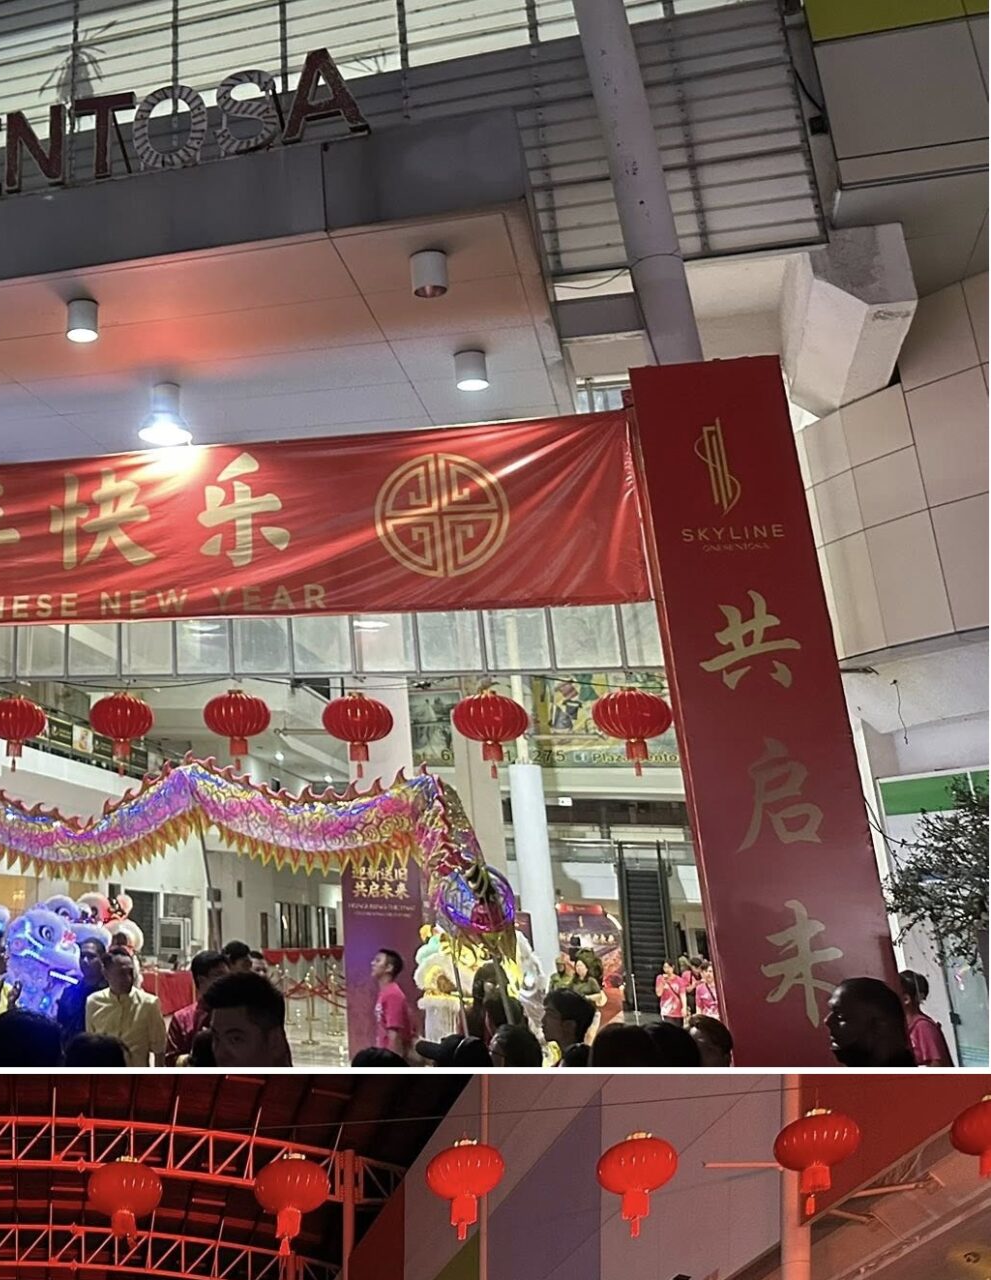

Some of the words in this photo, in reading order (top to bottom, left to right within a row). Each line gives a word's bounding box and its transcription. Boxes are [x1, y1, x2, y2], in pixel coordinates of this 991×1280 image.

[681, 524, 785, 542] SKYLINE
[100, 588, 189, 616] NEW
[211, 584, 327, 612] YEAR
[352, 881, 410, 900] 共启未来
